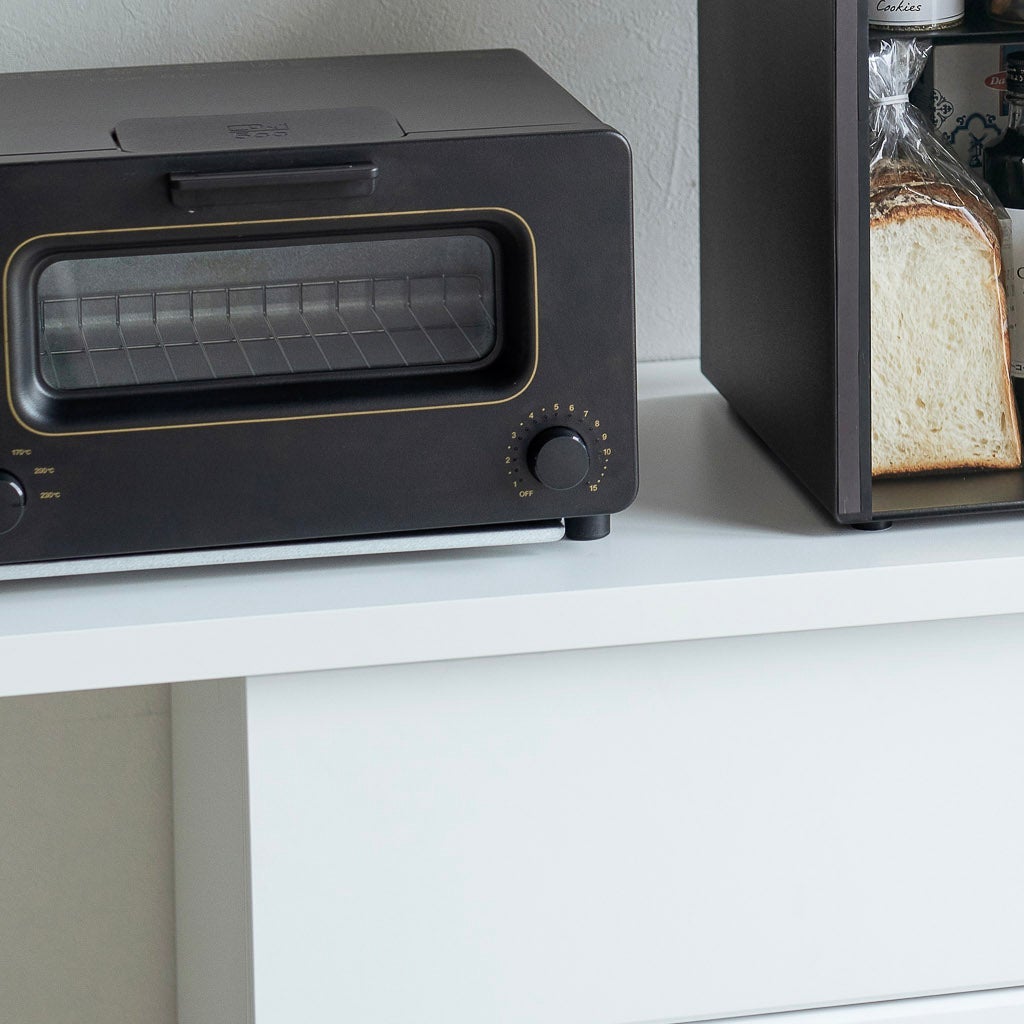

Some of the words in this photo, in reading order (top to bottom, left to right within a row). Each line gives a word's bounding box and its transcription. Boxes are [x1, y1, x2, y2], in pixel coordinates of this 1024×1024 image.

[876, 0, 922, 12] Cookies
[553, 403, 560, 411] 5
[568, 404, 575, 412] 6
[594, 419, 600, 427] 8
[511, 431, 517, 439] 3
[601, 433, 608, 441] 9
[603, 447, 612, 456] 10
[505, 456, 511, 464] 2
[589, 484, 598, 492] 15
[518, 489, 534, 498] OFF
